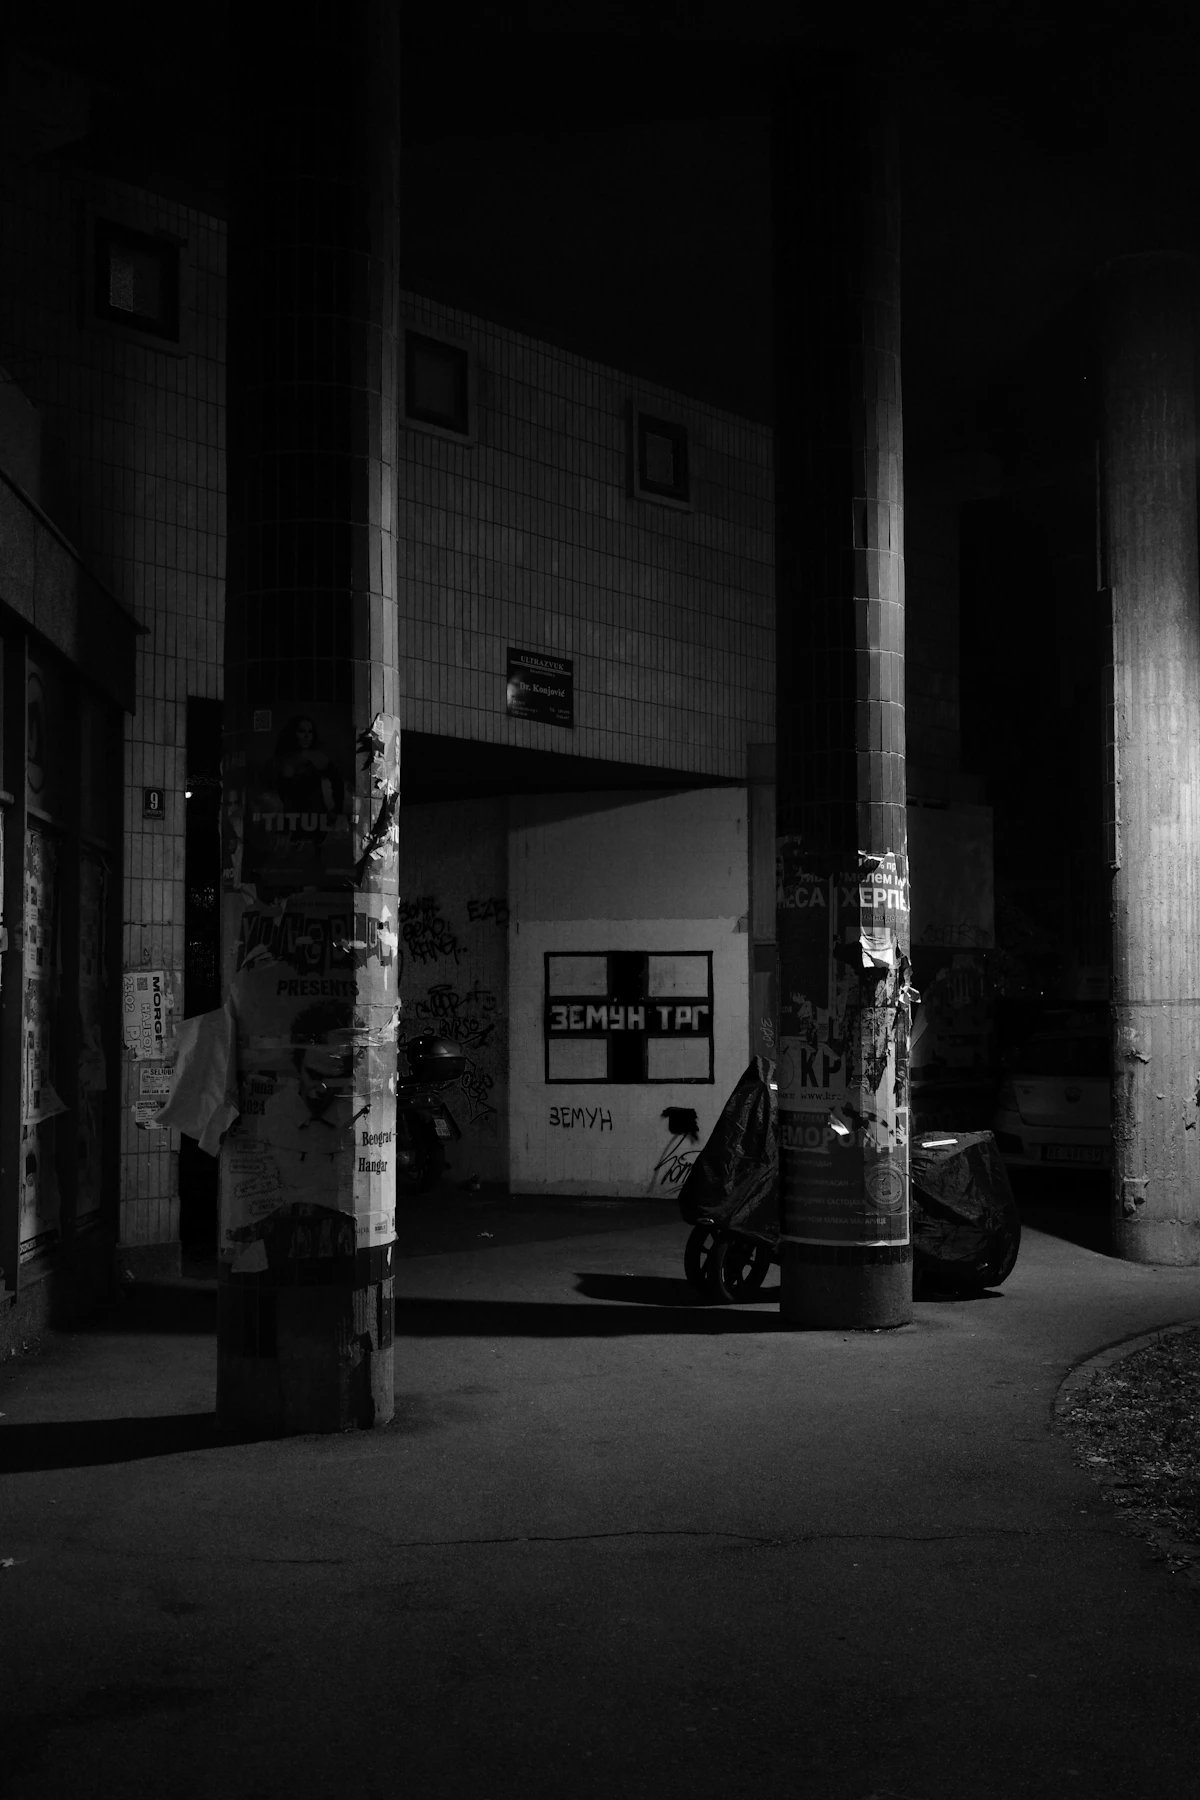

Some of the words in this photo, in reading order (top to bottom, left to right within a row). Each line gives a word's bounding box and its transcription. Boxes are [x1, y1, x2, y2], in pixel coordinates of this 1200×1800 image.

[520, 656, 564, 670] ULTRAZVUK
[519, 681, 532, 692] Dr.
[532, 683, 566, 698] Konjović
[150, 791, 158, 810] 9
[241, 914, 388, 966] YUNGBLU
[276, 979, 360, 997] PRESENTS
[549, 1004, 646, 1032] ЗЕМУН
[655, 1004, 710, 1032] ТРГ
[358, 1157, 388, 1175] Hangar
